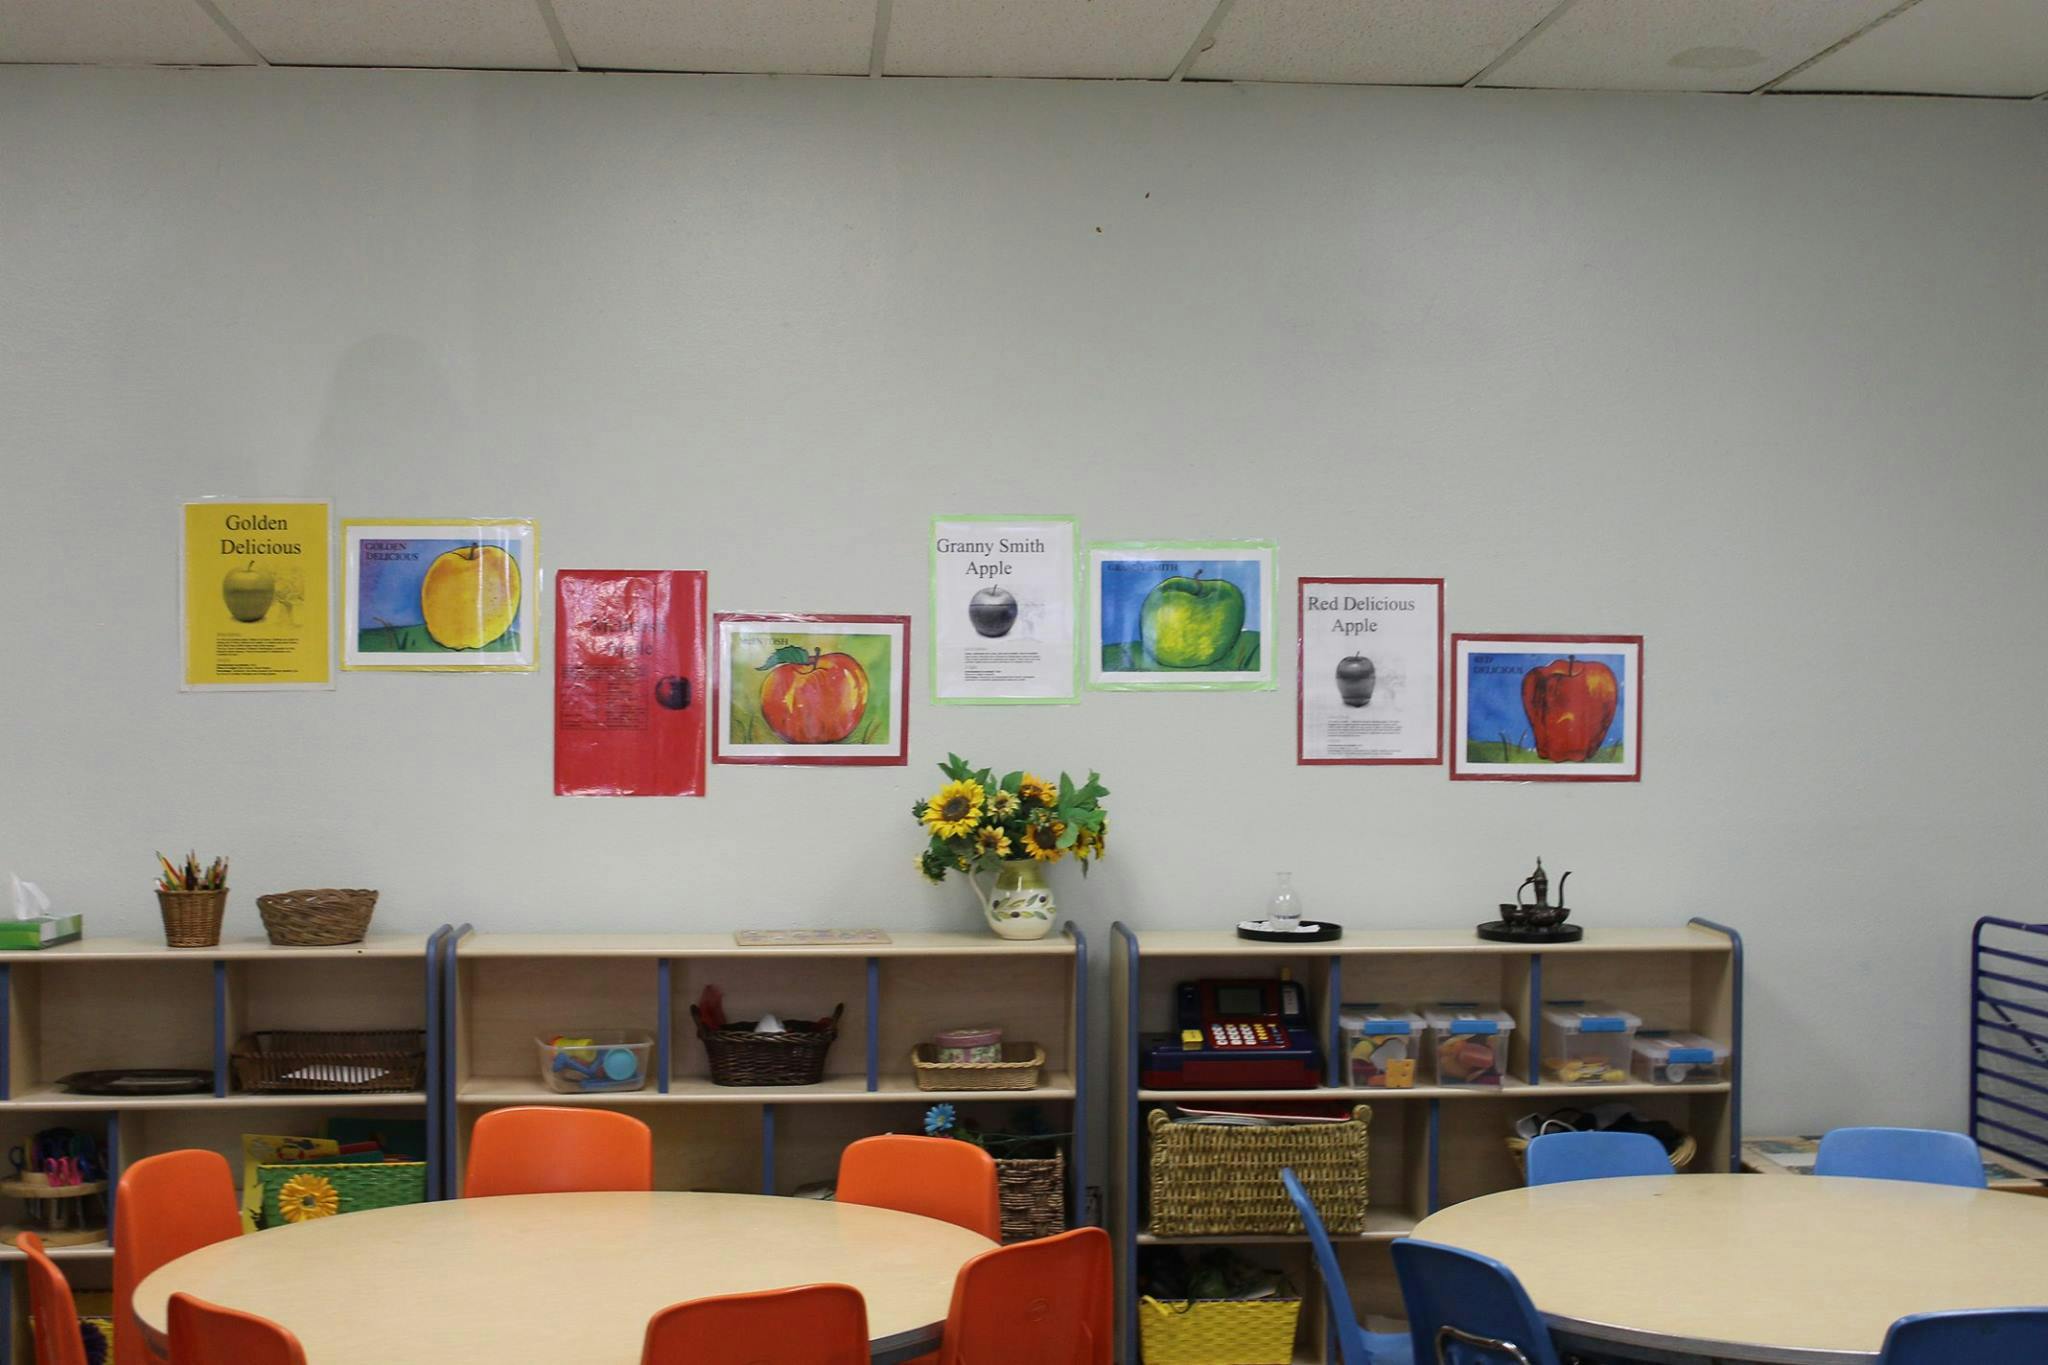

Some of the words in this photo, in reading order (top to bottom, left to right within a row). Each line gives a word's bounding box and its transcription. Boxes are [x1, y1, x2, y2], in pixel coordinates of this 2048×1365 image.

[226, 514, 288, 531] Golden
[221, 538, 302, 555] Delicious
[937, 538, 994, 556] Granny
[999, 538, 1045, 553] Smith
[965, 561, 1013, 579] Apple
[1308, 596, 1338, 611] Red
[1344, 596, 1416, 611] Delicious
[1331, 618, 1378, 636] Apple
